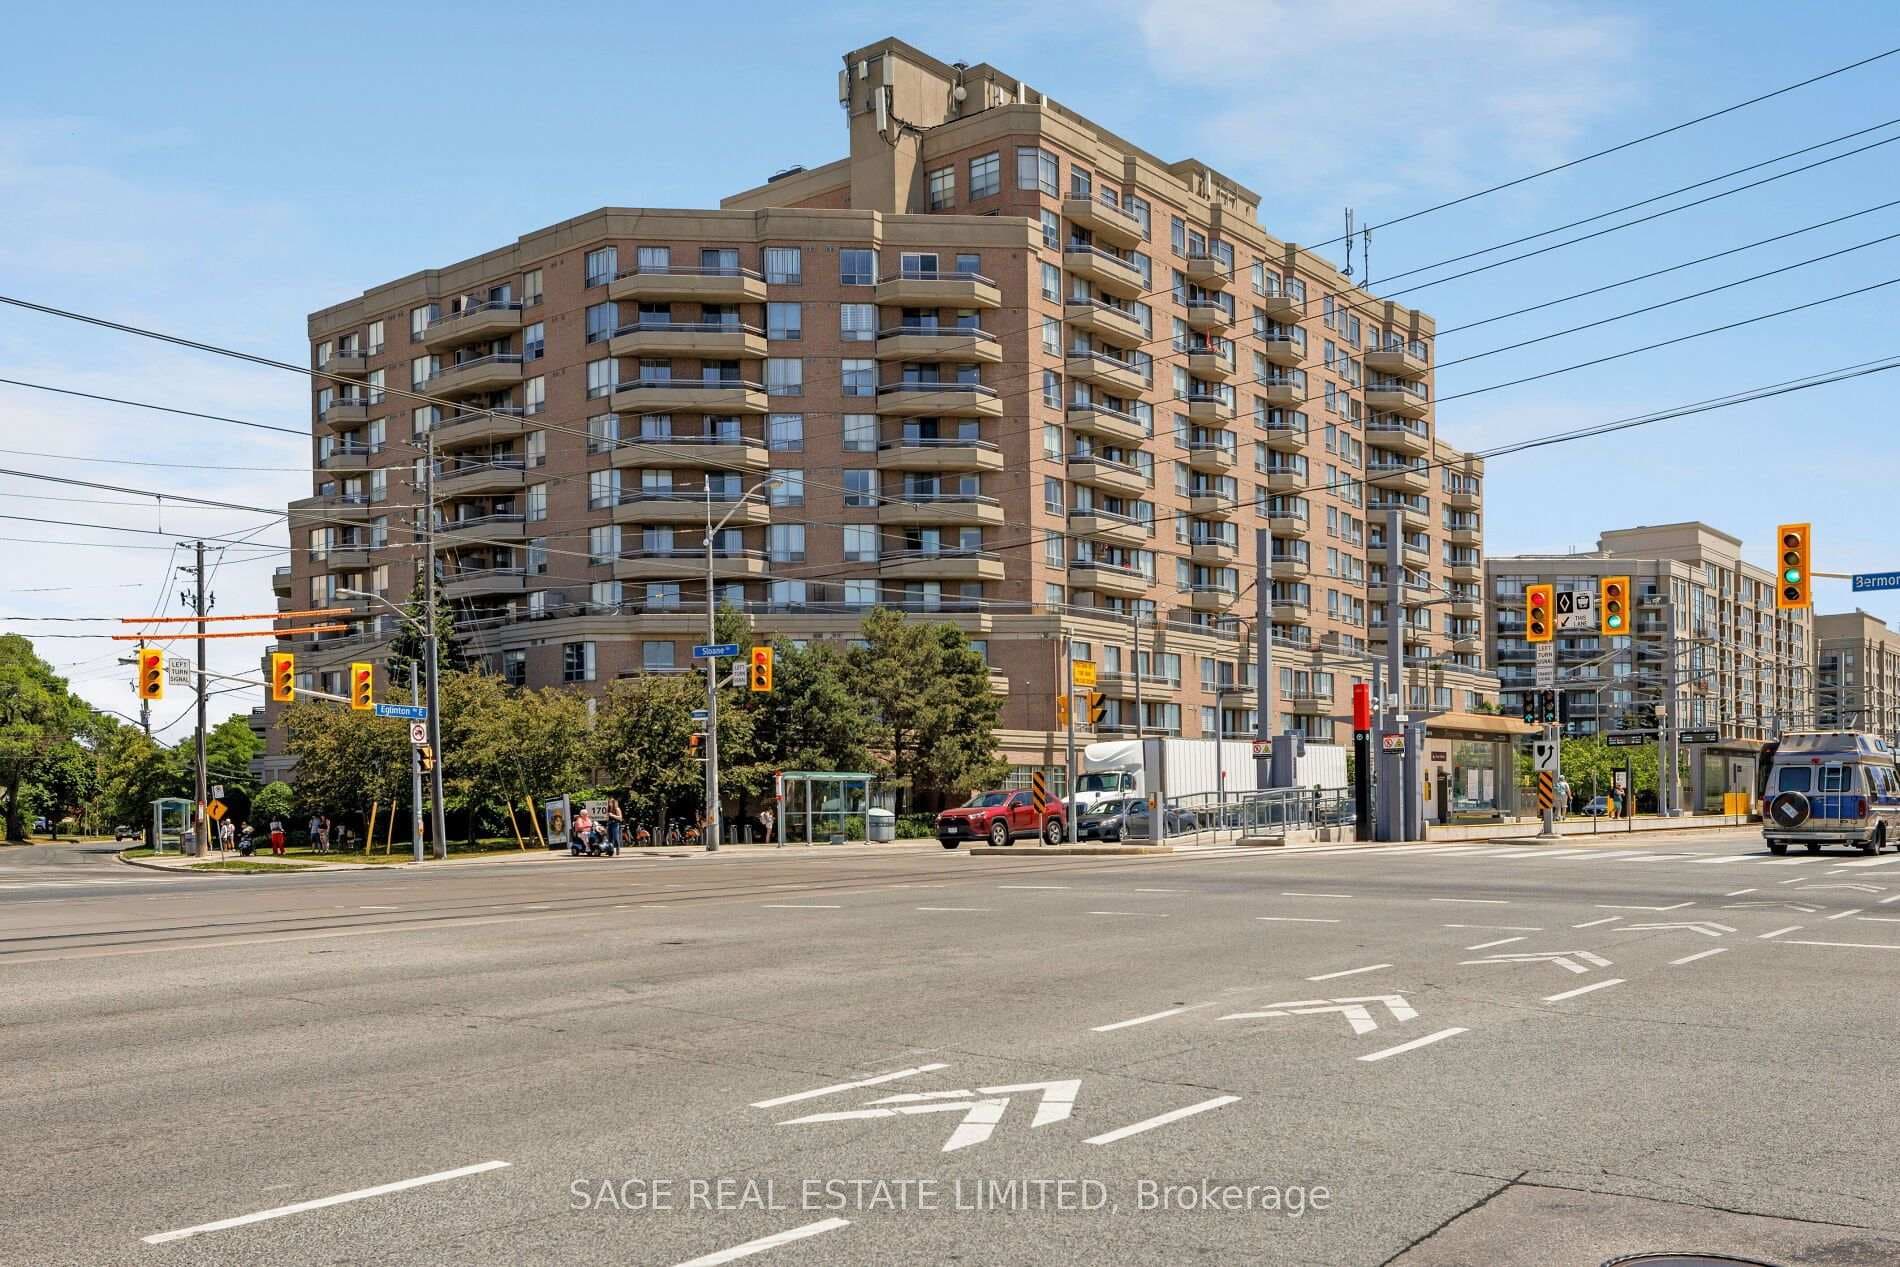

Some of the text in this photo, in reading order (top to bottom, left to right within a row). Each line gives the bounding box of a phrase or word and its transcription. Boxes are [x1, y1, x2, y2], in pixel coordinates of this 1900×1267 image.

[702, 647, 725, 656] Sloane
[380, 705, 410, 716] Eglinton
[418, 708, 424, 717] E
[592, 806, 607, 815] 170
